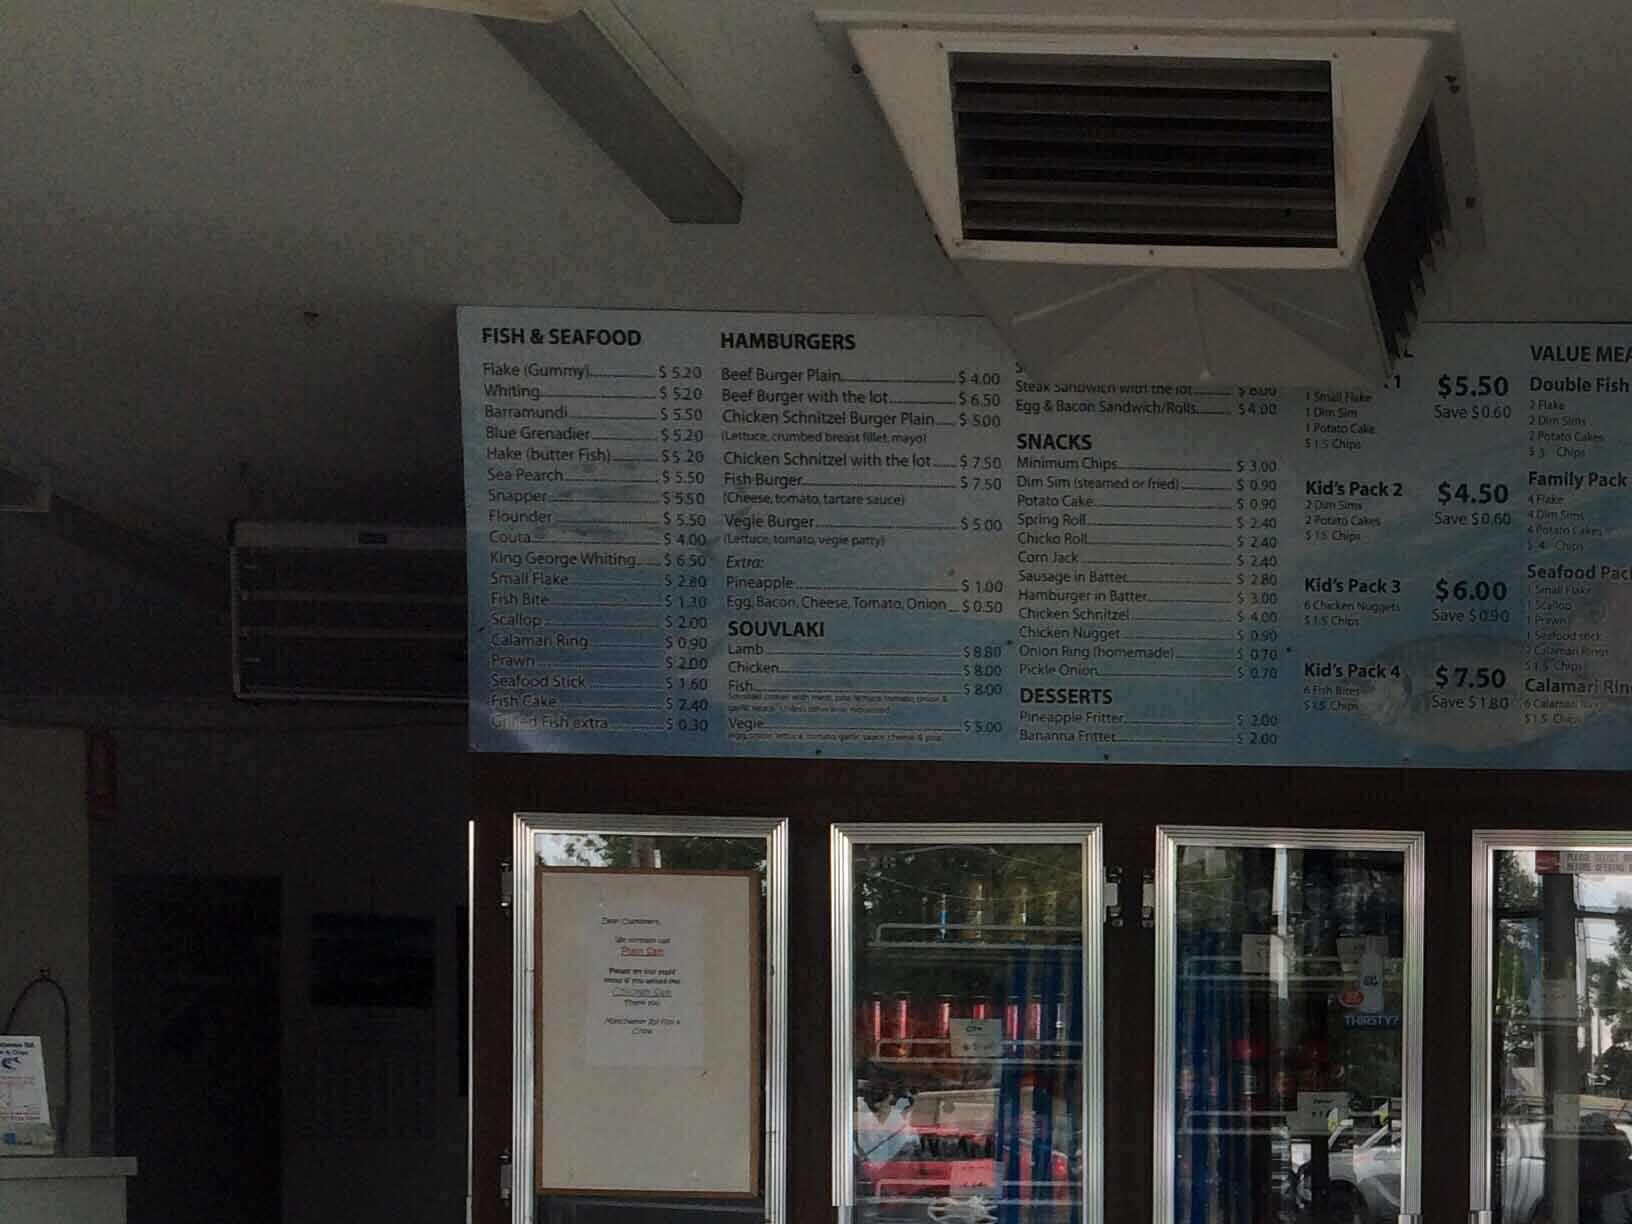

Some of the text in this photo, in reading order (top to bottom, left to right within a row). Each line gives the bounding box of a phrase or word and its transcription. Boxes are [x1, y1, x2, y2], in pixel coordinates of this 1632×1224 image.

[482, 328, 641, 346] FISH & SEAFOOD
[720, 332, 856, 350] HAMBURGERS
[1530, 345, 1590, 362] VALUE
[483, 363, 590, 381] Flake (Gummy)
[722, 368, 841, 386] Beef Burger Plain
[1438, 373, 1509, 399] $5.50
[1529, 377, 1592, 392] Double
[1596, 379, 1629, 392] Fish
[485, 385, 540, 400] Whiting
[722, 389, 888, 406] Beef Burger with the lot
[485, 405, 567, 418] Barramundi
[1016, 402, 1040, 415] Egg
[1044, 402, 1053, 412] &
[1056, 402, 1095, 413] Bacon
[722, 410, 934, 428] Chicken Schnitzel Burger Plain
[486, 427, 590, 441] Blue Grenadier
[1016, 433, 1092, 450] SNACKS
[487, 448, 611, 464] Hake (butter Fish)
[723, 451, 847, 466] Chicken Schnitzel
[1017, 457, 1118, 471] Minimum Chips
[488, 469, 563, 482] Sea Pearch
[724, 472, 803, 489] Fish Burger
[1017, 477, 1070, 488] Dim Sim
[1528, 472, 1628, 489] Family Pack
[1305, 481, 1403, 497] Kid's Pack 2
[1438, 481, 1509, 505] $4.50
[489, 489, 547, 506] Snapper
[1017, 495, 1094, 508] Potato Cake
[489, 511, 552, 523] Flounder
[725, 514, 814, 530] Vegie Burger
[1017, 514, 1086, 528] Spring Roll
[490, 531, 531, 544] Couta
[1064, 533, 1087, 545] Roll
[491, 553, 636, 569] King George Whiting
[726, 556, 764, 569] Extra:
[1052, 552, 1078, 564] Jack
[1018, 572, 1128, 585] Sausage in Batter
[1527, 564, 1596, 580] Seafood
[491, 574, 568, 586] Small Flake
[726, 577, 793, 592] Pineapple
[1305, 578, 1400, 593] Kid's Pack 3
[491, 593, 547, 606] Fish Bite
[1018, 590, 1090, 604] Hamburger
[492, 613, 542, 628] Scallop
[1019, 608, 1129, 621] Chicken Schnitzel
[727, 621, 824, 637] SOUVLAKI
[1019, 627, 1120, 642] Chicken Nugget
[556, 635, 588, 650] Ring
[728, 644, 764, 655] Lamb
[492, 655, 534, 667] Prawn
[728, 662, 779, 674] Chicken
[1304, 663, 1400, 679] Kid's Pack 4
[492, 675, 585, 689] Seafood Stick
[728, 681, 752, 692] Fish
[1525, 679, 1598, 692] Calamari
[1020, 688, 1112, 705] DESSERTS
[728, 718, 764, 731] Vegie
[1344, 1015, 1399, 1026] THIRSTY?
